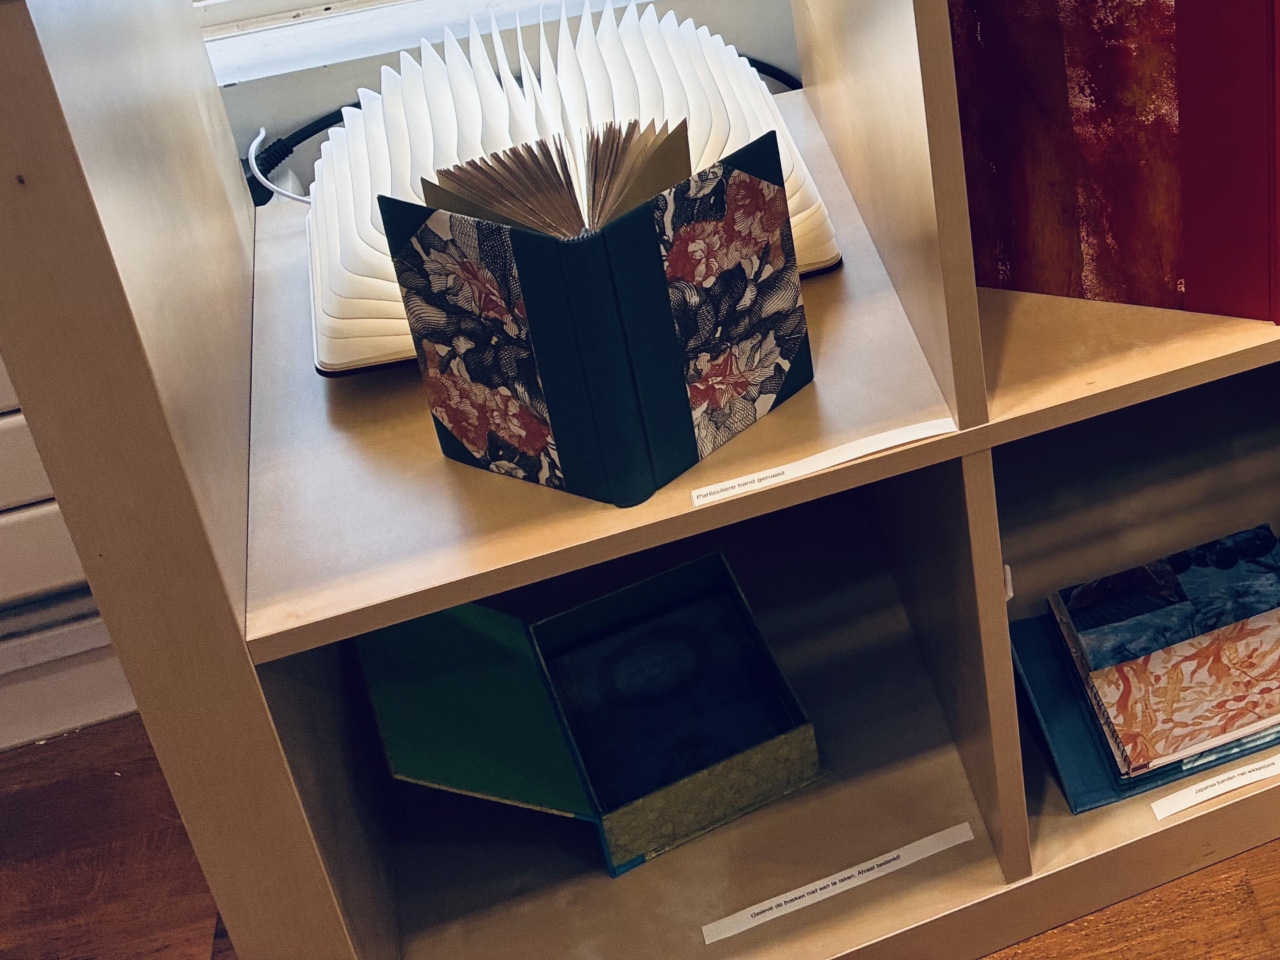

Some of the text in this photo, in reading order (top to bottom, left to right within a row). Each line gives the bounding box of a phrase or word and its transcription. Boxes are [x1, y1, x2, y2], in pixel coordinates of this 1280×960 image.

[696, 471, 785, 500] Particuliere band genaaid
[1194, 783, 1217, 794] Japanse
[1216, 774, 1236, 785] banden
[857, 865, 875, 876] Alvast
